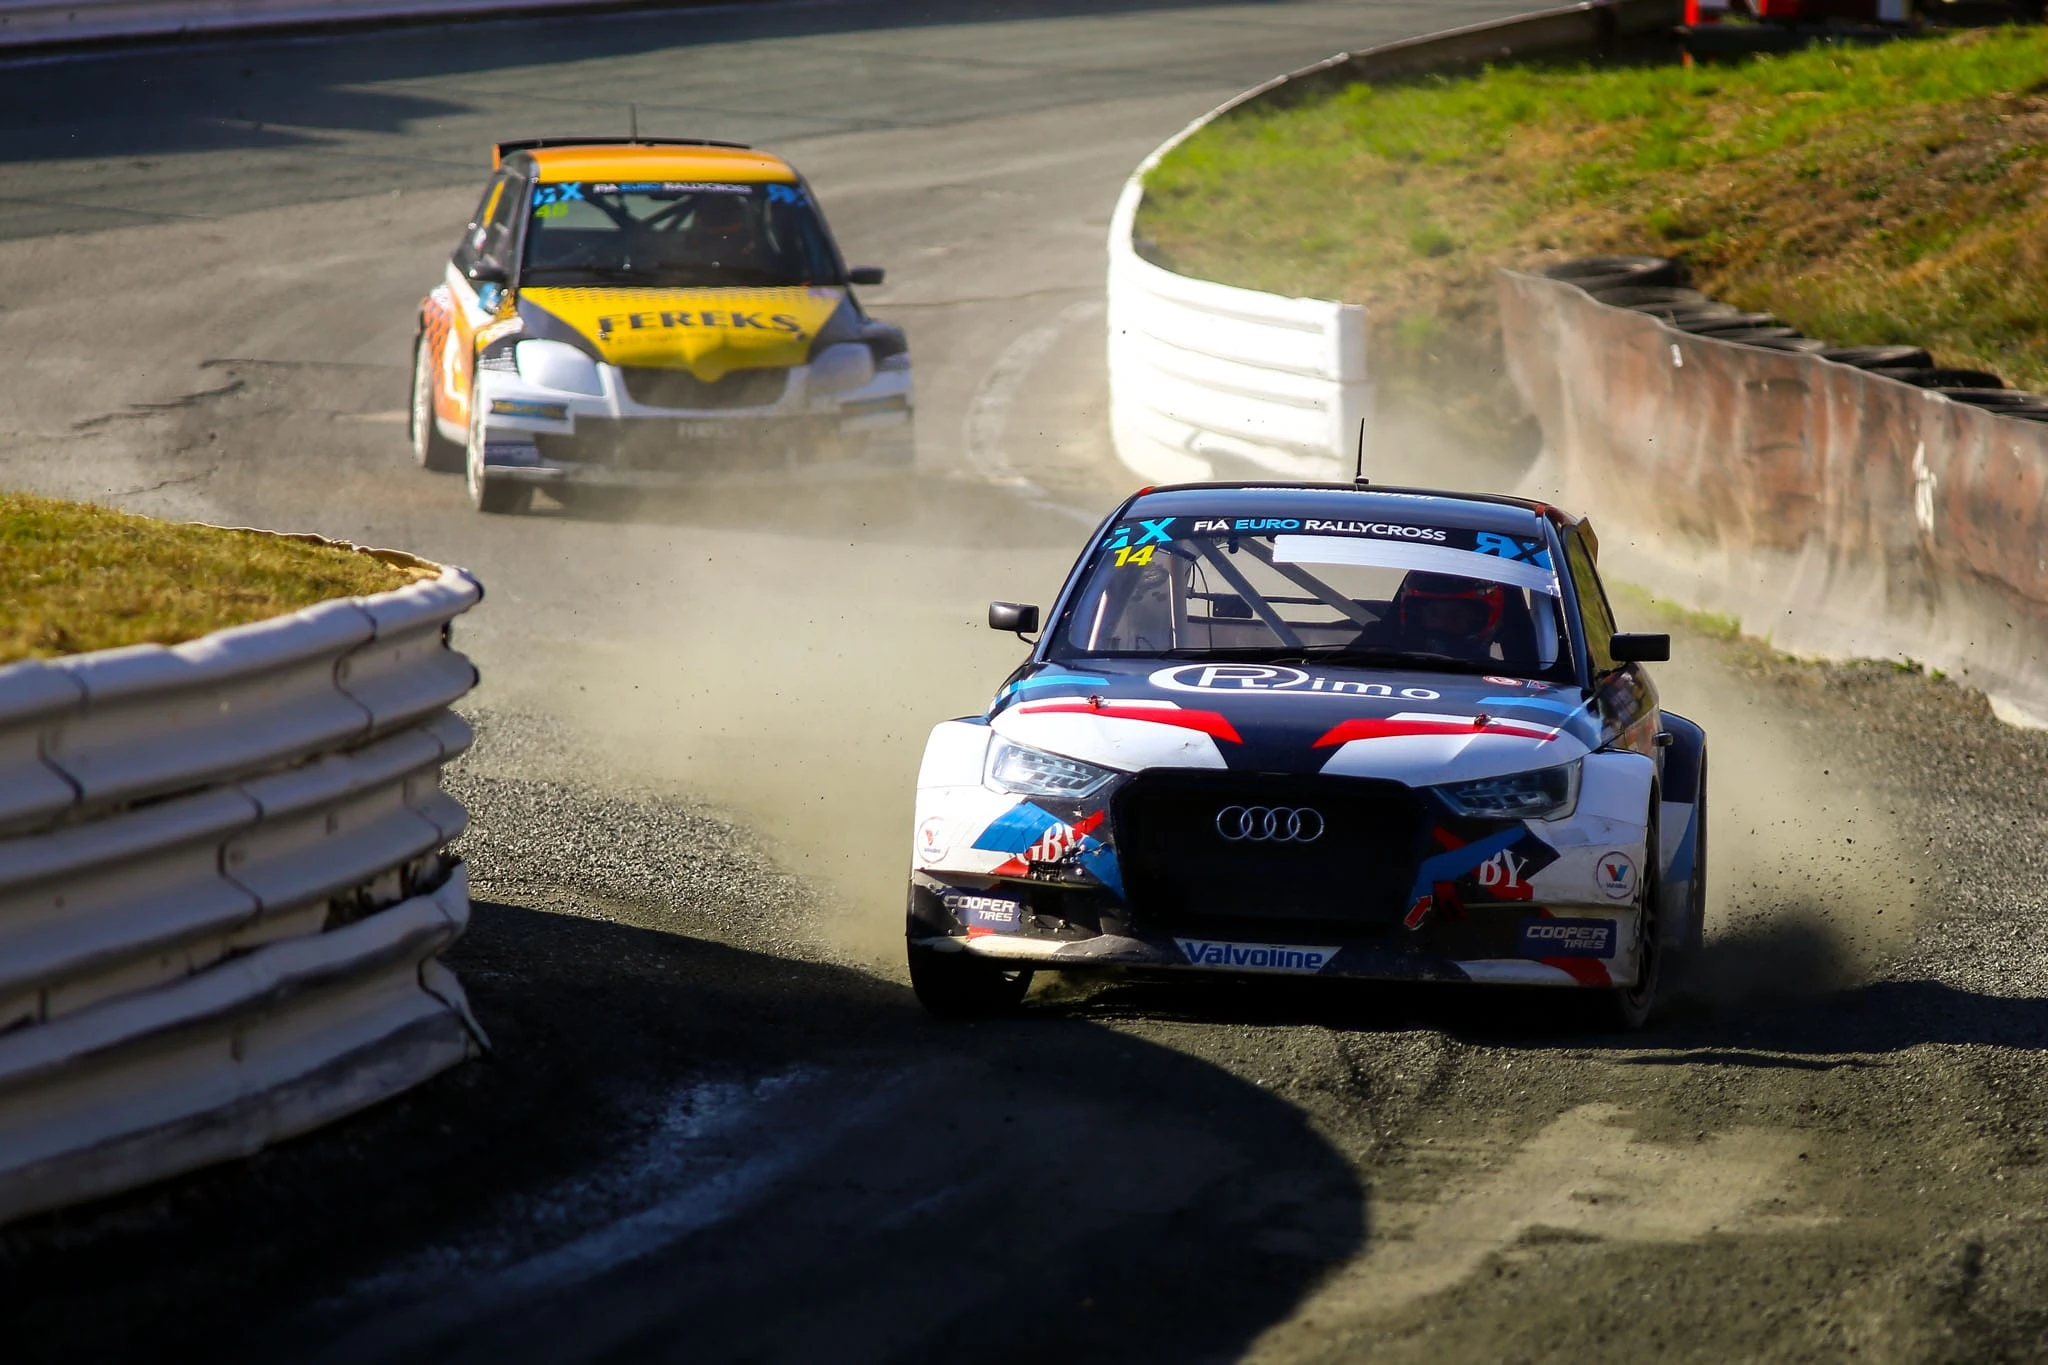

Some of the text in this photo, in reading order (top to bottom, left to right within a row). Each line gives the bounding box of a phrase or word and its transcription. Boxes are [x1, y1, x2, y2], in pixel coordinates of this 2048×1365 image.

[598, 310, 800, 333] FEREKS
[1193, 518, 1447, 541] FIA EURO RALLYCROSS
[1113, 545, 1156, 568] 14
[1148, 663, 1442, 701] Rimo
[943, 895, 1016, 914] COOPER
[979, 910, 1014, 922] TIRES
[1526, 925, 1609, 940] COOPER
[1563, 938, 1605, 949] TIRES
[1184, 942, 1323, 970] Valvoline
